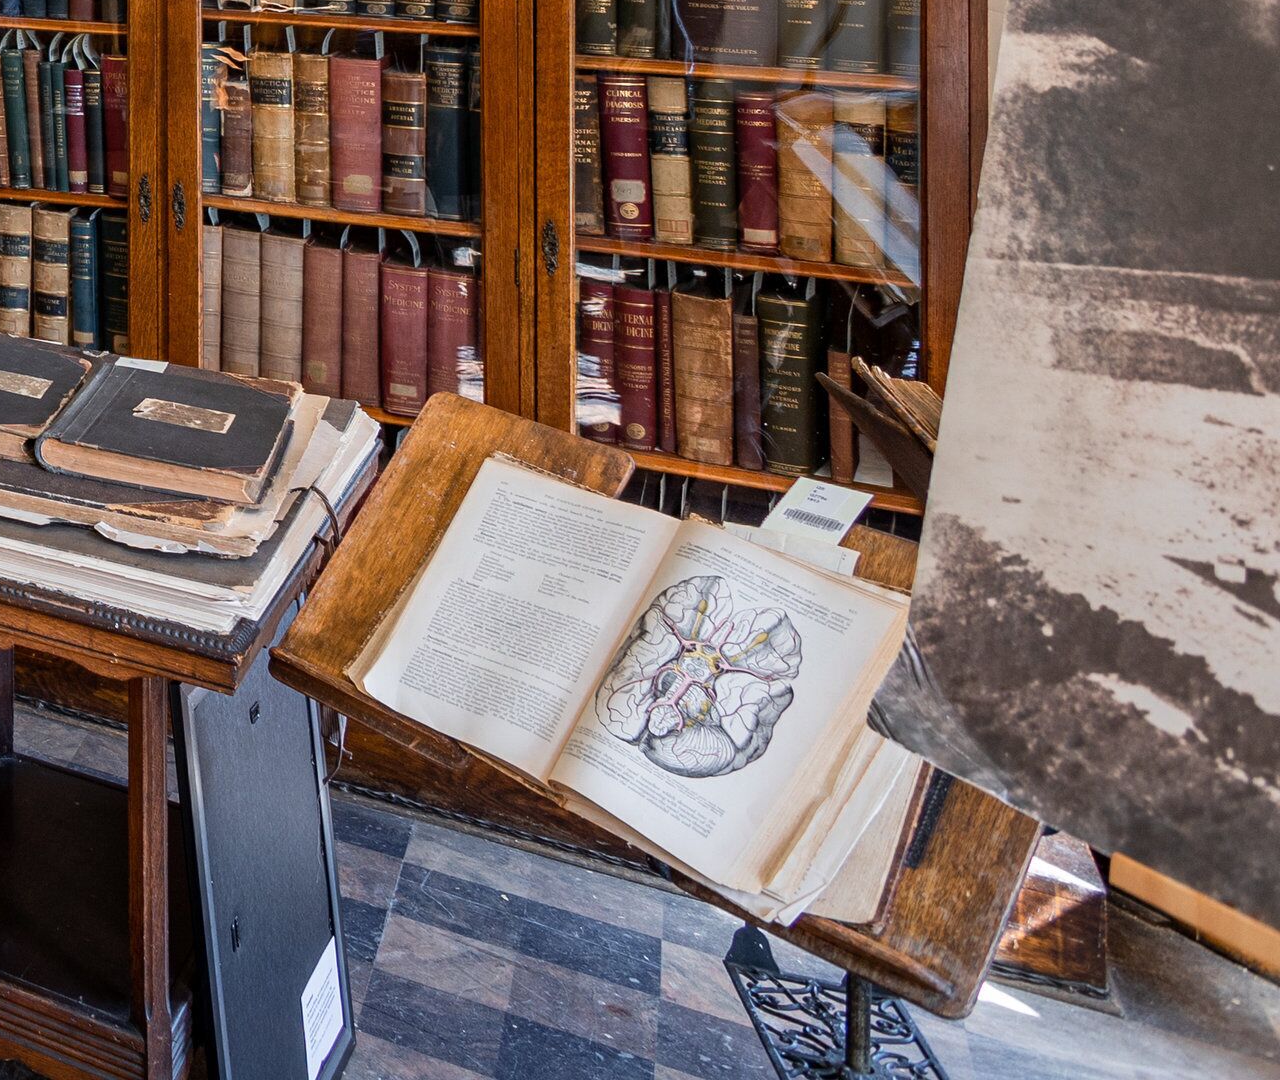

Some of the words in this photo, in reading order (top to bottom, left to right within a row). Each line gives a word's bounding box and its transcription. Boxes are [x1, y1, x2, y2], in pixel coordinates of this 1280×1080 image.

[606, 89, 642, 97] CLINICAL
[606, 101, 643, 109] DIAGNOSIS
[389, 280, 421, 293] SYSTEM
[384, 294, 424, 310] MEDICINE
[430, 300, 472, 315] MEDICINE
